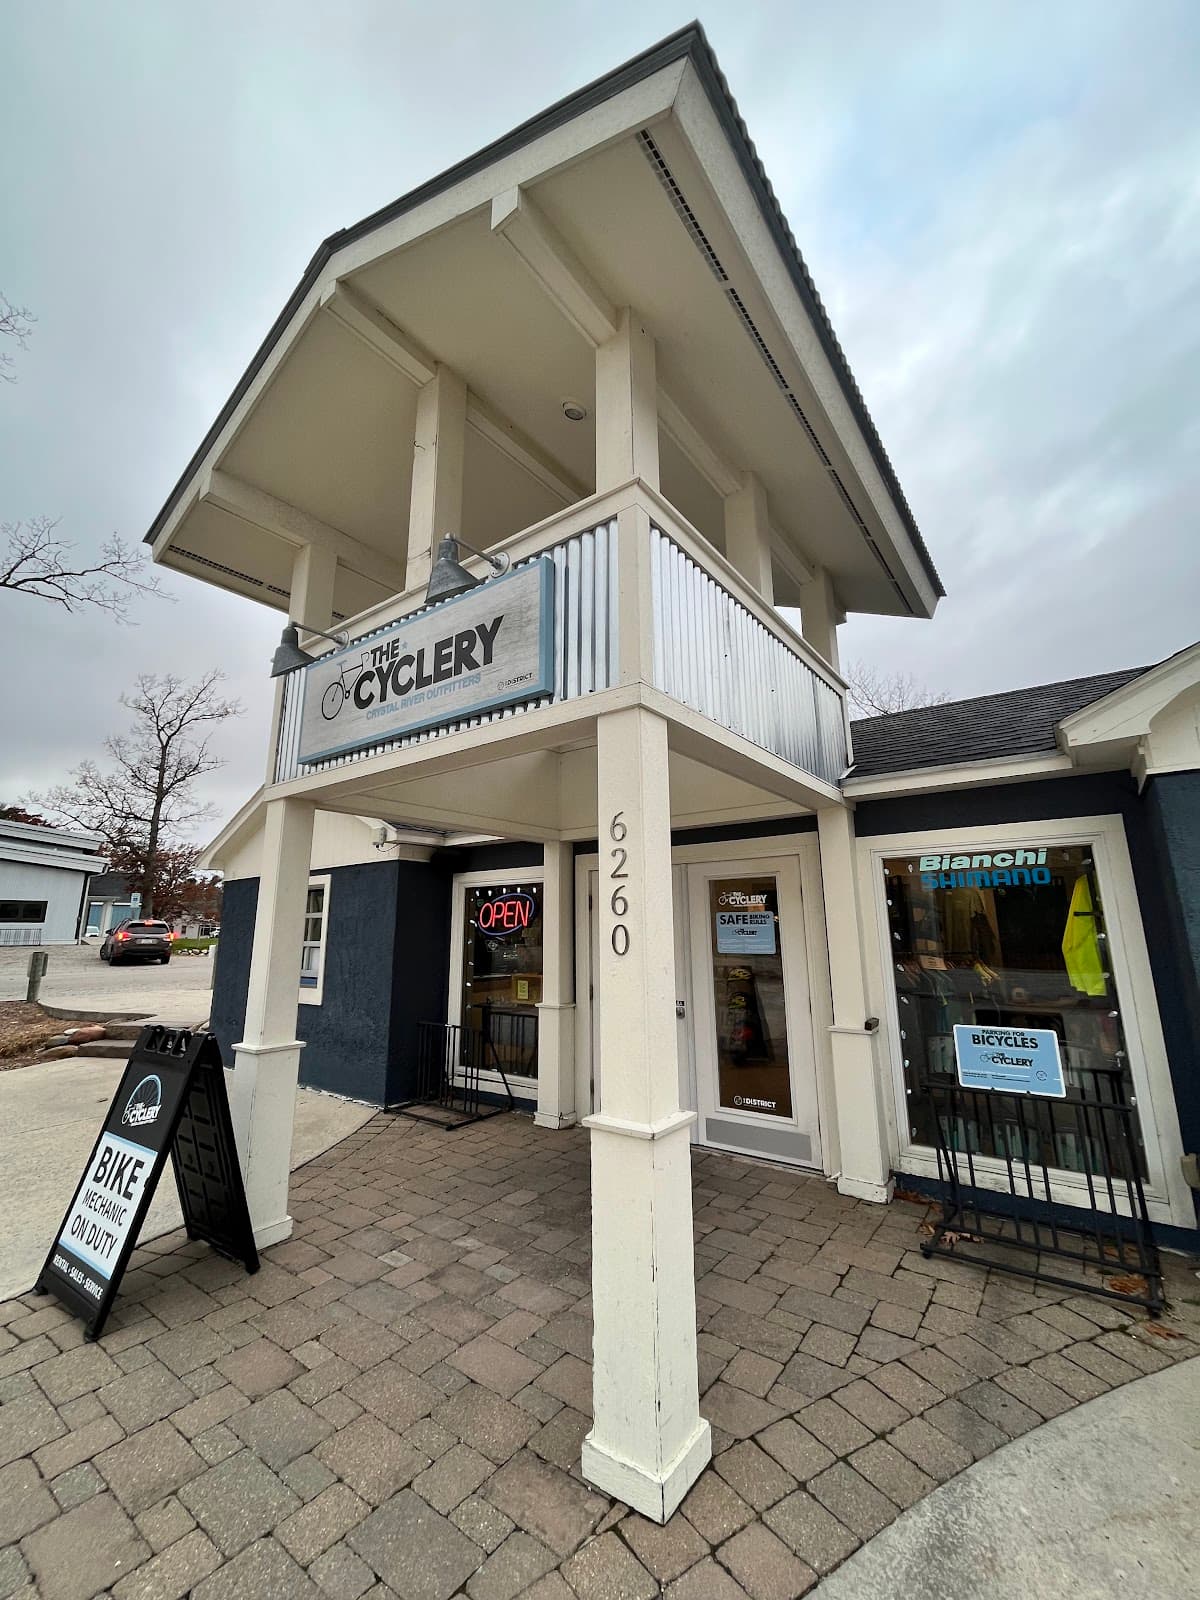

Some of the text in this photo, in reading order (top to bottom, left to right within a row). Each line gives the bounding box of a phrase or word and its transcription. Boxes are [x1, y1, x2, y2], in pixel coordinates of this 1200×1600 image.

[354, 615, 505, 709] CYCLERY
[370, 637, 400, 668] THE
[366, 673, 482, 721] CRYSTAL RIVER OUTFITTERS
[919, 847, 1048, 872] Bianchi
[609, 811, 630, 956] 6260
[921, 867, 1051, 889] SHIMANO
[729, 895, 767, 904] CYCLERY
[480, 900, 530, 928] OPEN
[720, 914, 749, 925] SAFE
[972, 1034, 1039, 1049] BICYCLES
[991, 1056, 1034, 1067] CYCLERY
[130, 1105, 161, 1123] CYCLERY
[745, 1097, 777, 1109] DISTRICT
[92, 1146, 145, 1200] BIKE
[82, 1188, 127, 1227] MECHANIC
[71, 1214, 118, 1259] ON DUTY
[69, 1266, 84, 1284] SALES
[83, 1278, 104, 1300] SERVICE
